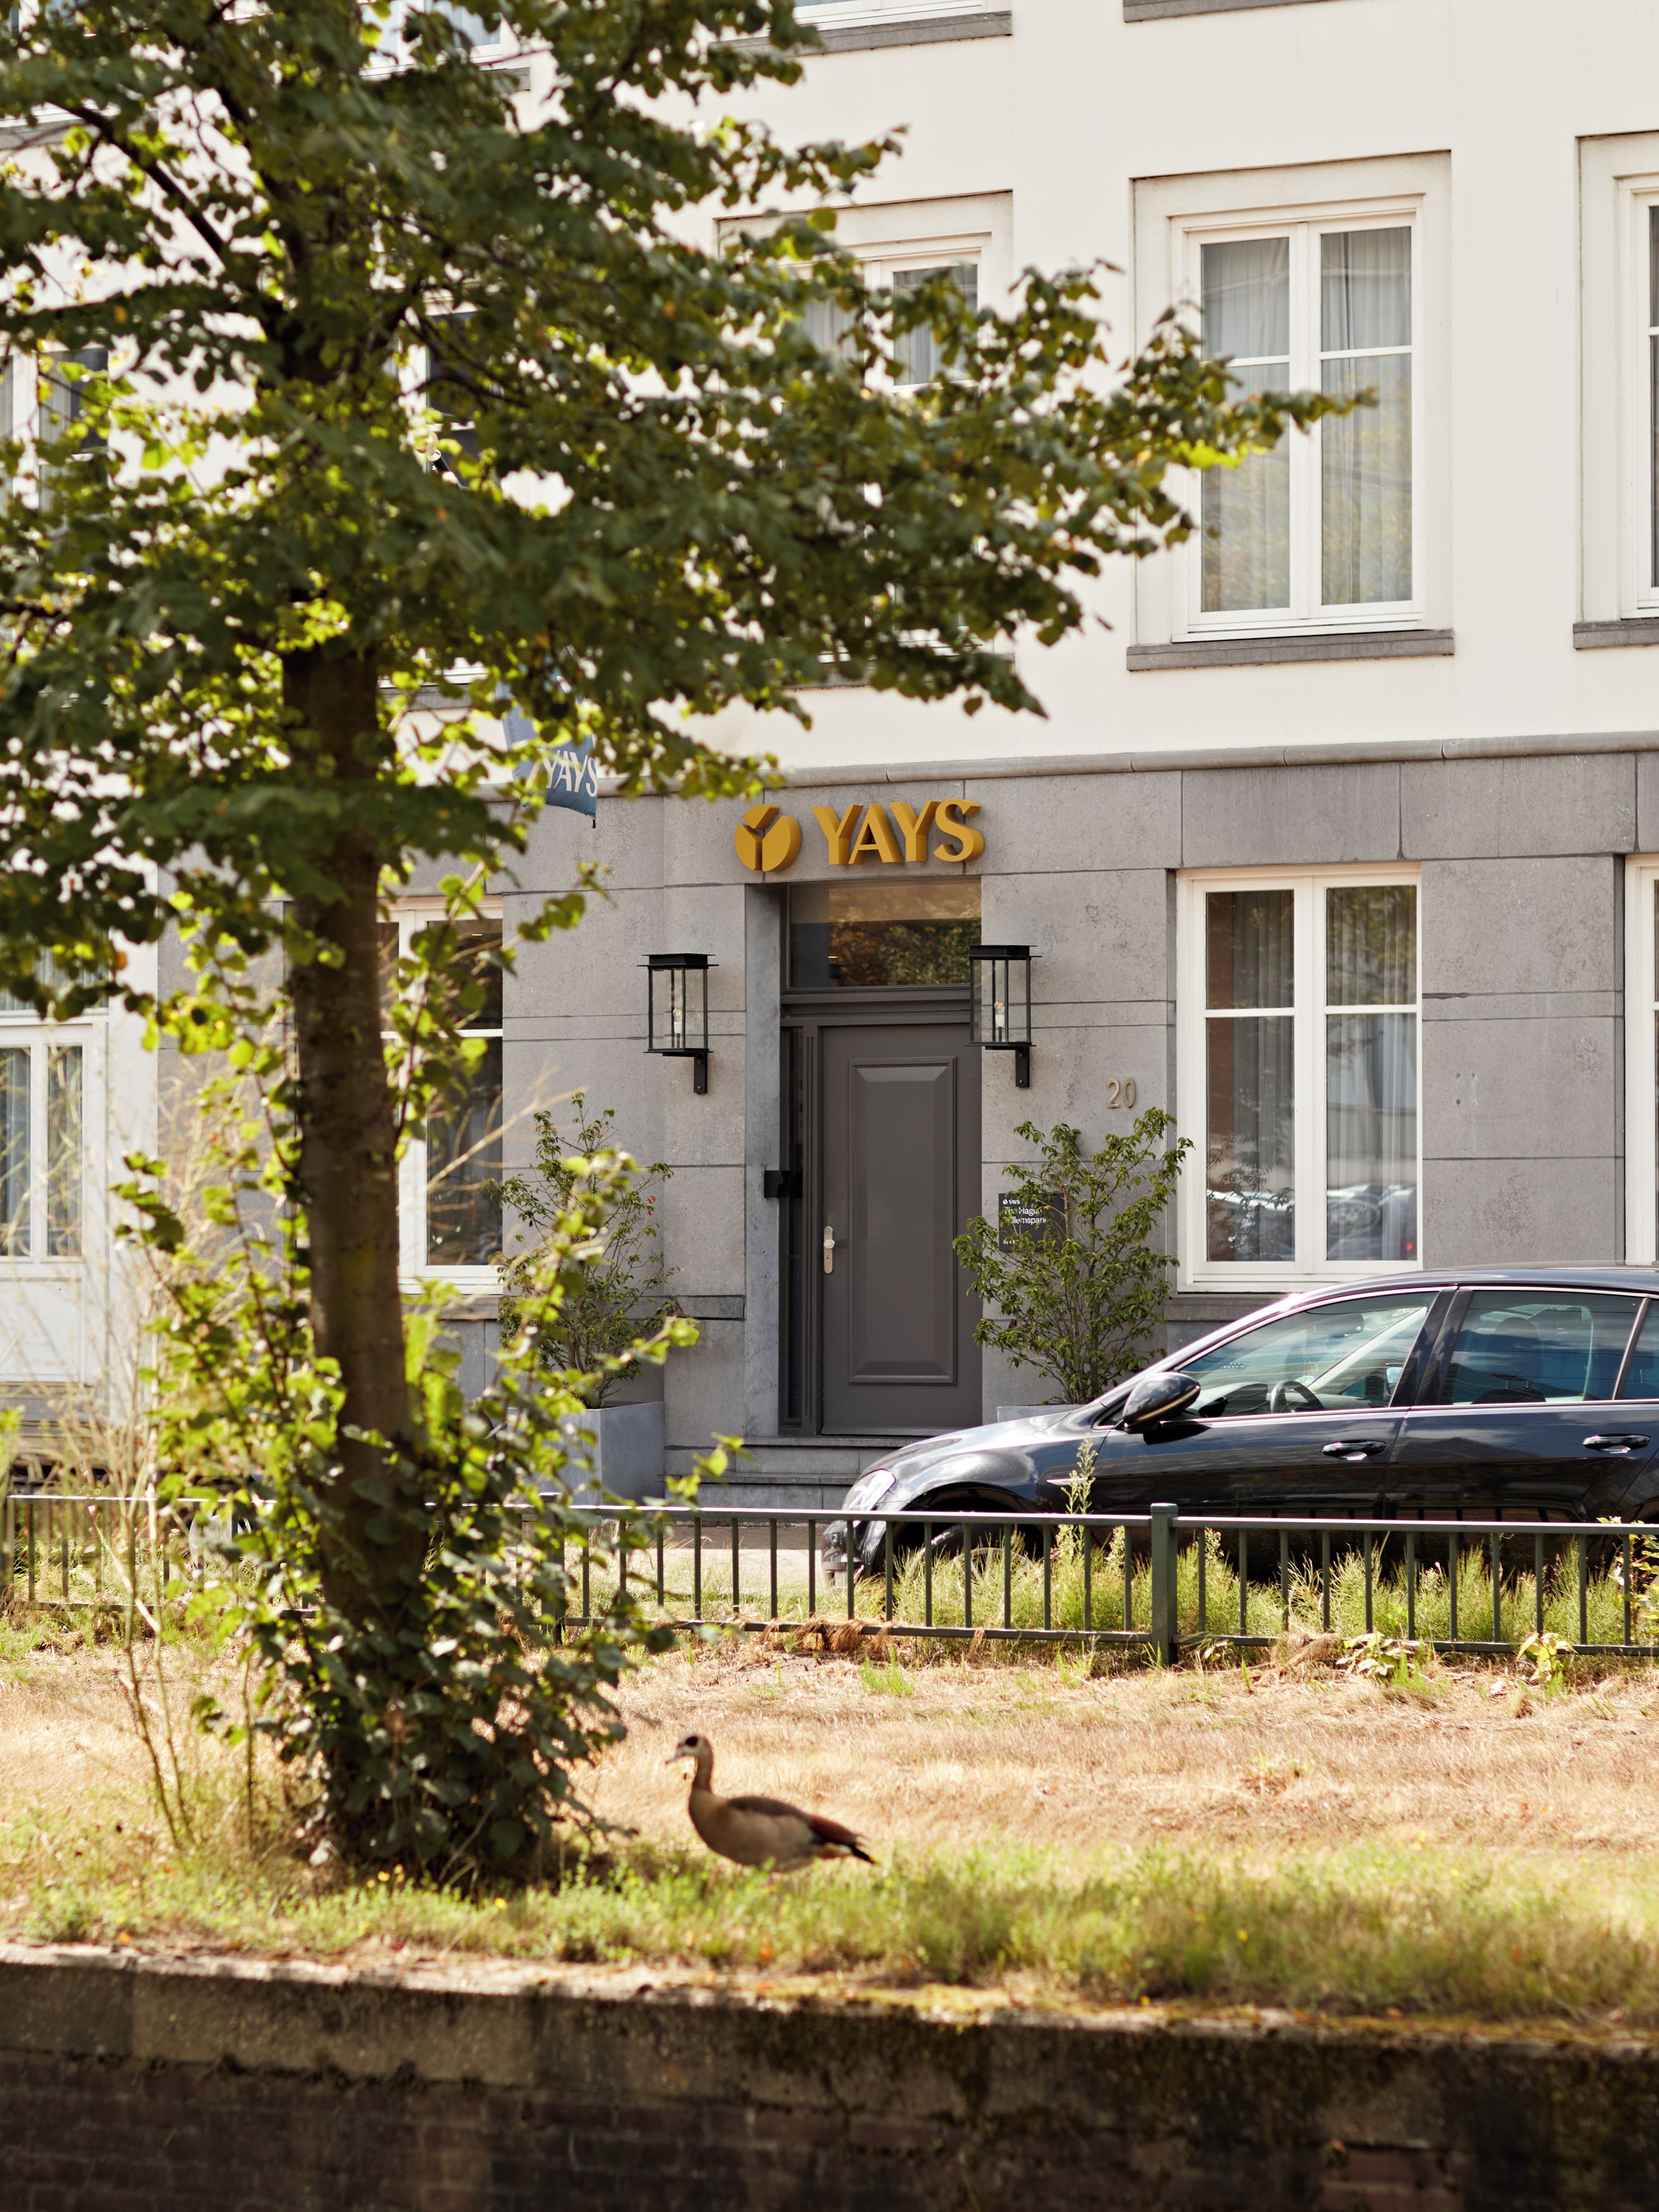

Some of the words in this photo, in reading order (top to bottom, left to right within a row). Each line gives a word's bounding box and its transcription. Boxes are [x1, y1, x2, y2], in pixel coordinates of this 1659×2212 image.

[542, 750, 597, 798] YAYS
[811, 799, 984, 865] YAYS
[1107, 1077, 1136, 1109] 20
[1003, 1216, 1047, 1225] llemspark
